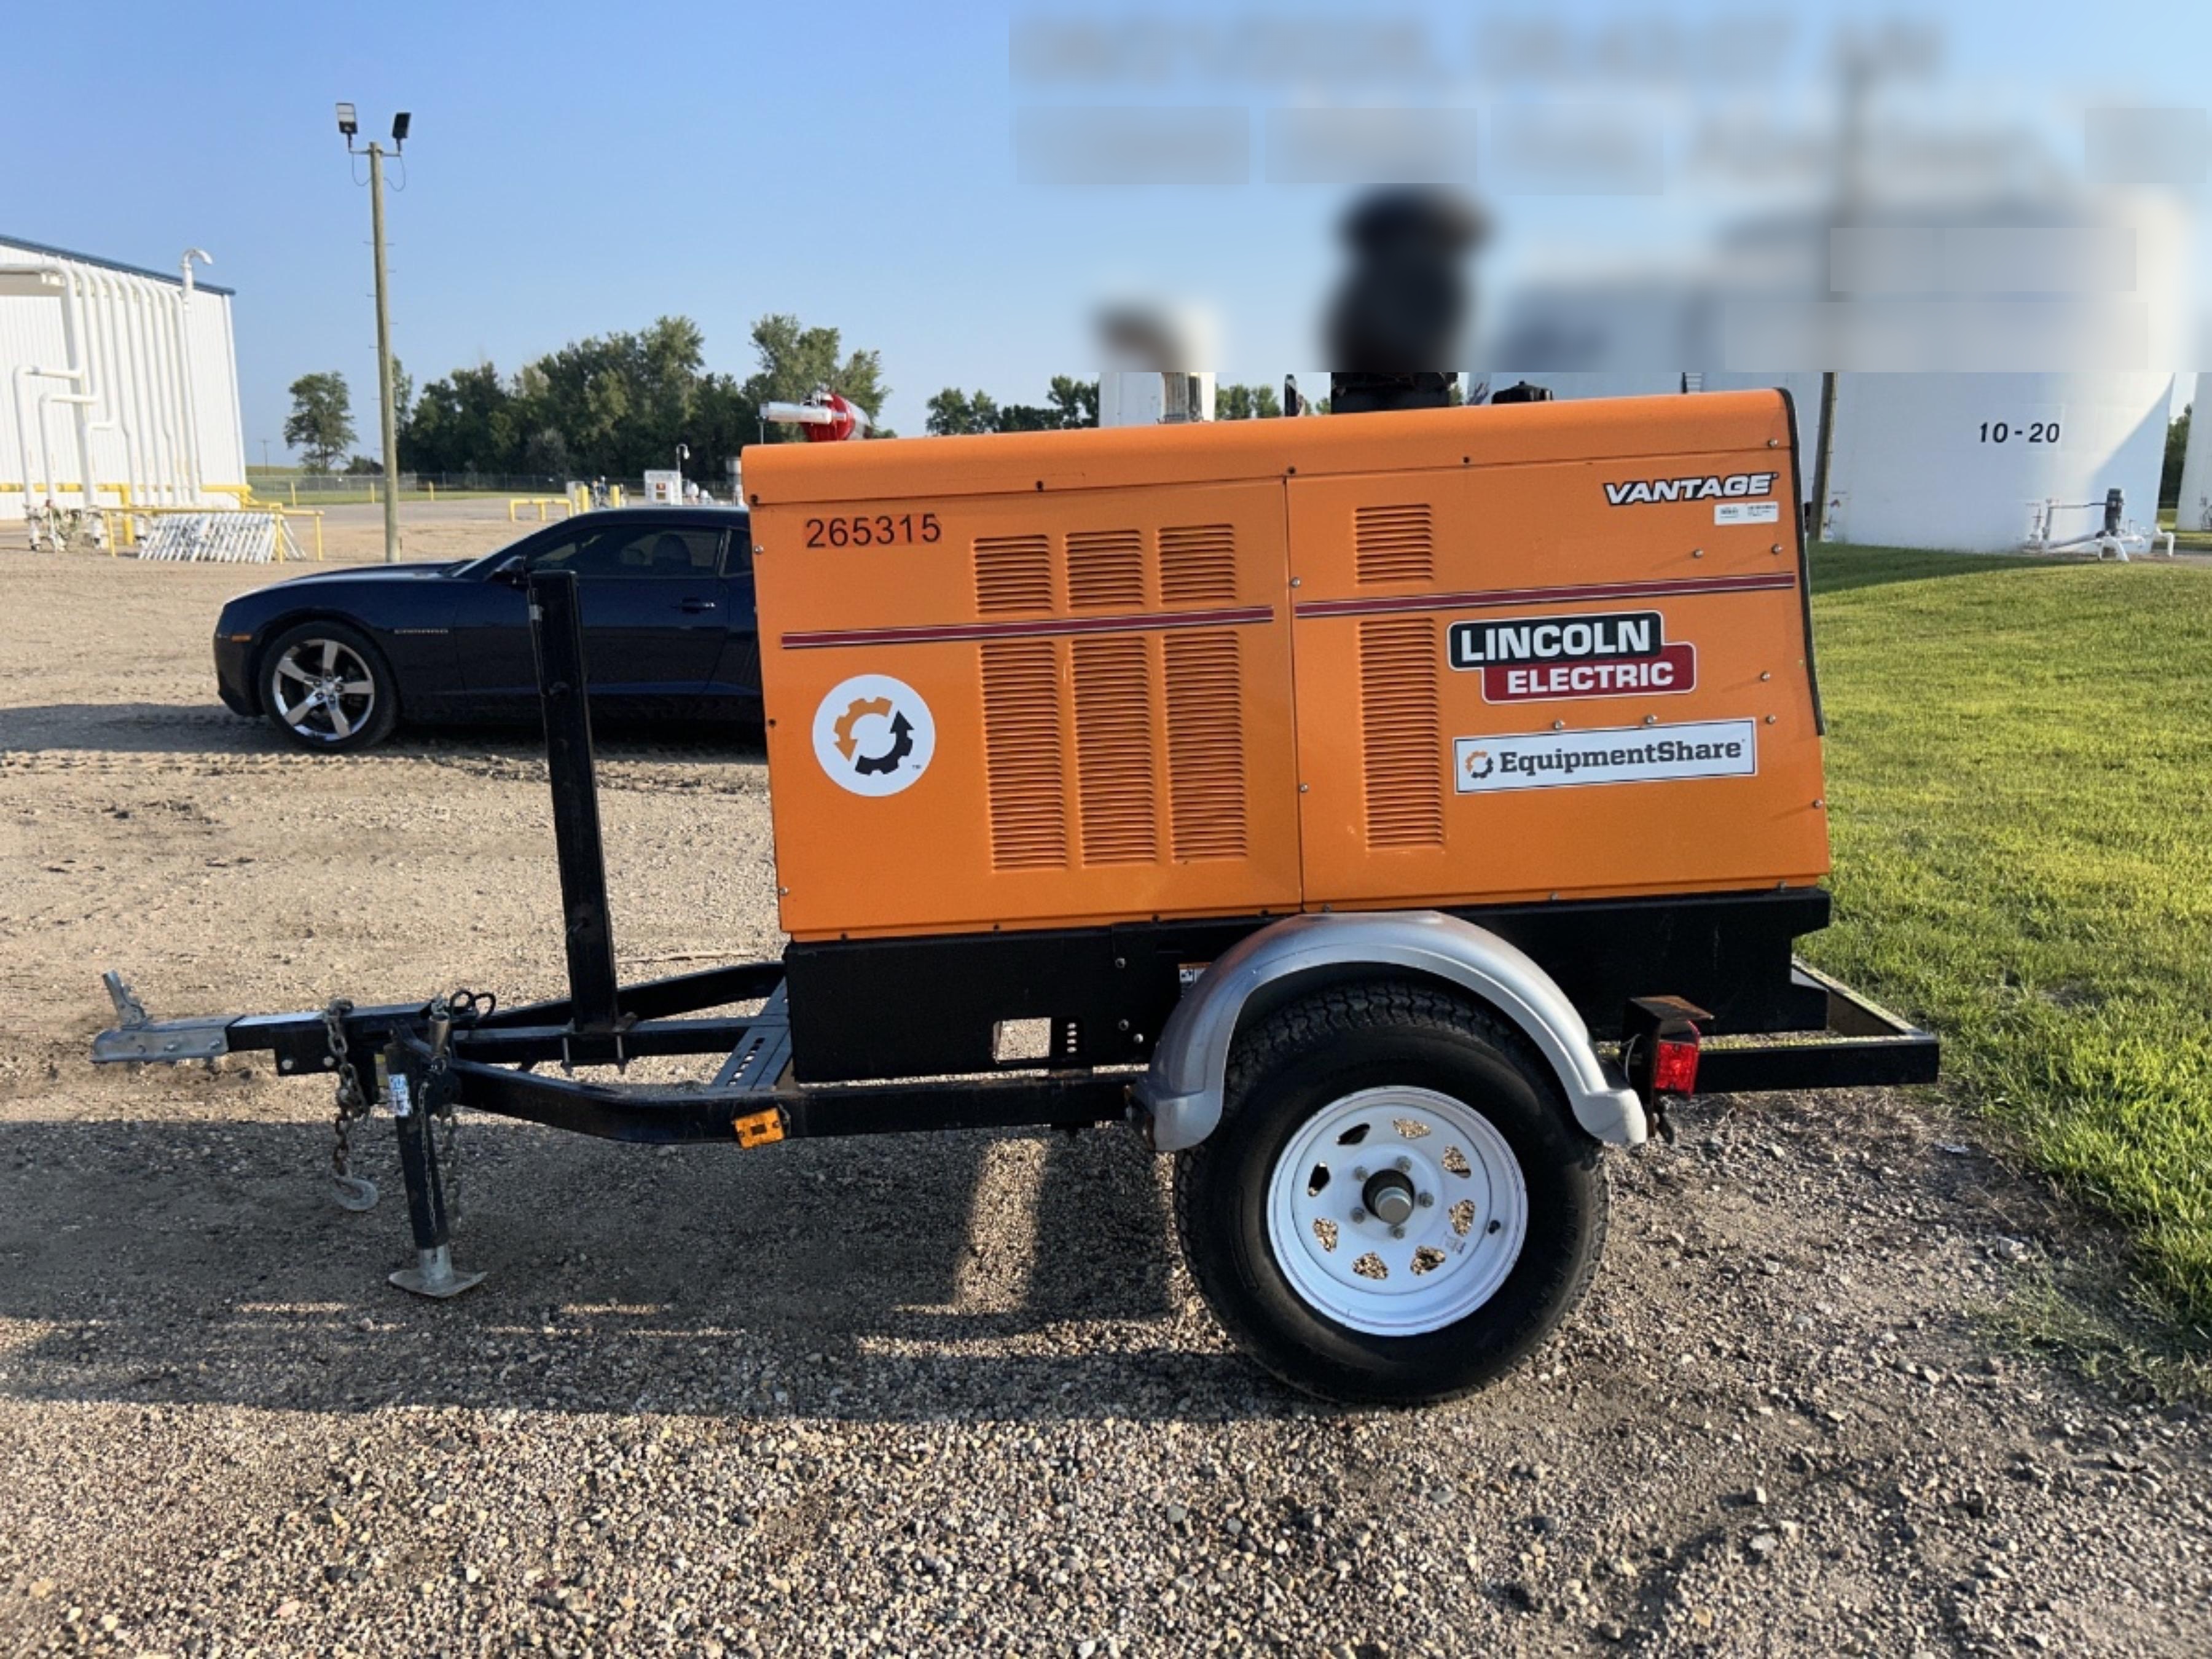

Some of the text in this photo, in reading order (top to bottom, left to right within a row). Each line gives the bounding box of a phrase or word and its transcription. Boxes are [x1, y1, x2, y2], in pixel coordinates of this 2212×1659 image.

[1604, 473, 1773, 506] VANTAGE
[806, 513, 942, 548] 265315
[1461, 619, 1650, 662] LINCOLN
[1507, 661, 1674, 694] ELECTRIC
[1499, 740, 1742, 775] EquipmentShare
